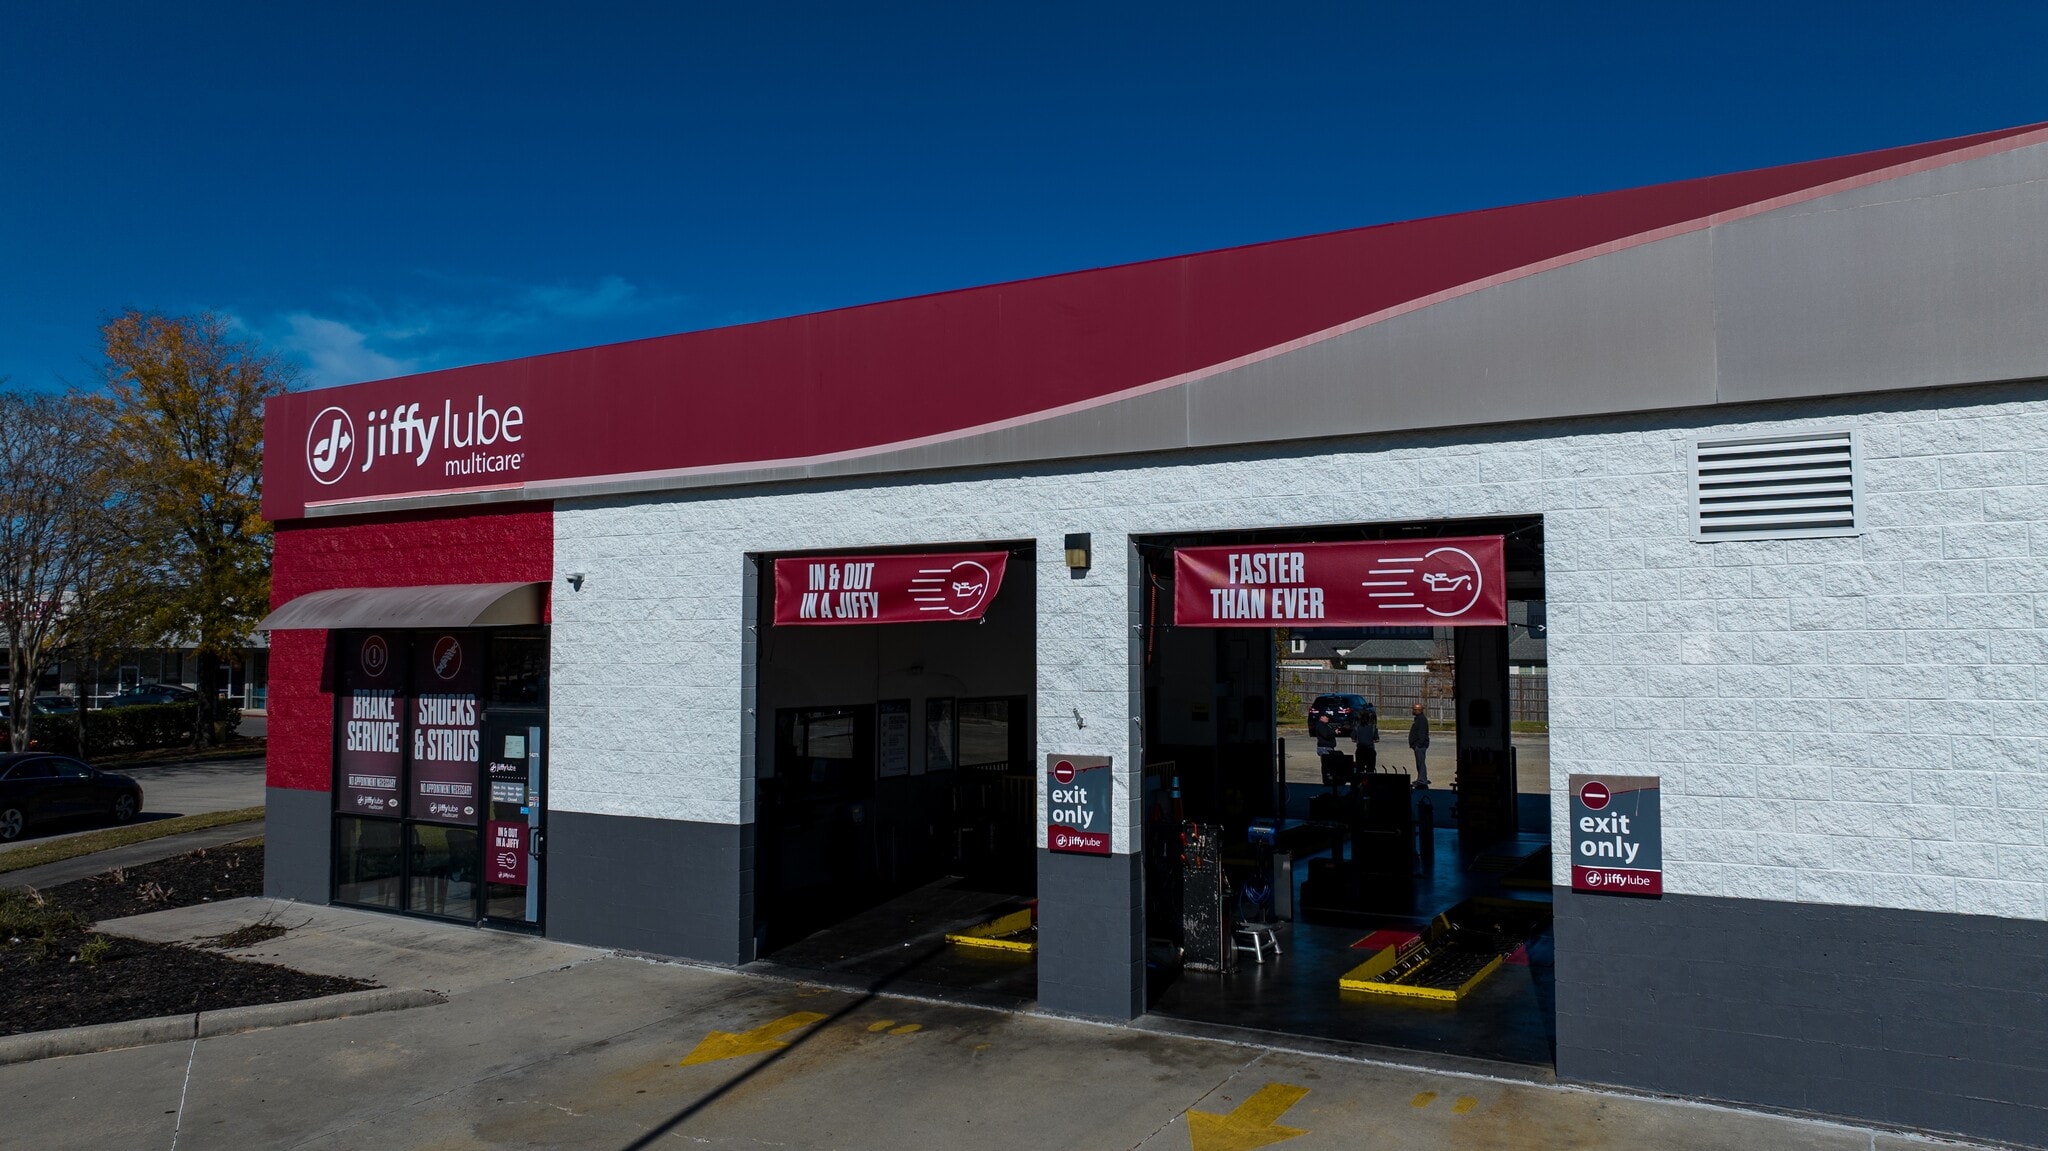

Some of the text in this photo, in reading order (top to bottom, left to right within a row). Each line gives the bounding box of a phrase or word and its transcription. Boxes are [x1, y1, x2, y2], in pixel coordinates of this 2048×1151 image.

[809, 563, 874, 590] IN & OUT
[1229, 552, 1304, 584] FASTER
[800, 592, 878, 618] IN A JIFFY
[1210, 587, 1324, 619] THAN EVER
[352, 689, 395, 719] BRAKE
[419, 694, 475, 725] SHOCKS
[347, 721, 399, 752] SERVICE
[415, 729, 424, 759] &
[427, 730, 479, 761] STRUTS
[1052, 785, 1087, 804] exit
[1053, 805, 1093, 829] only
[1579, 811, 1630, 834] exit
[1580, 836, 1639, 864] only
